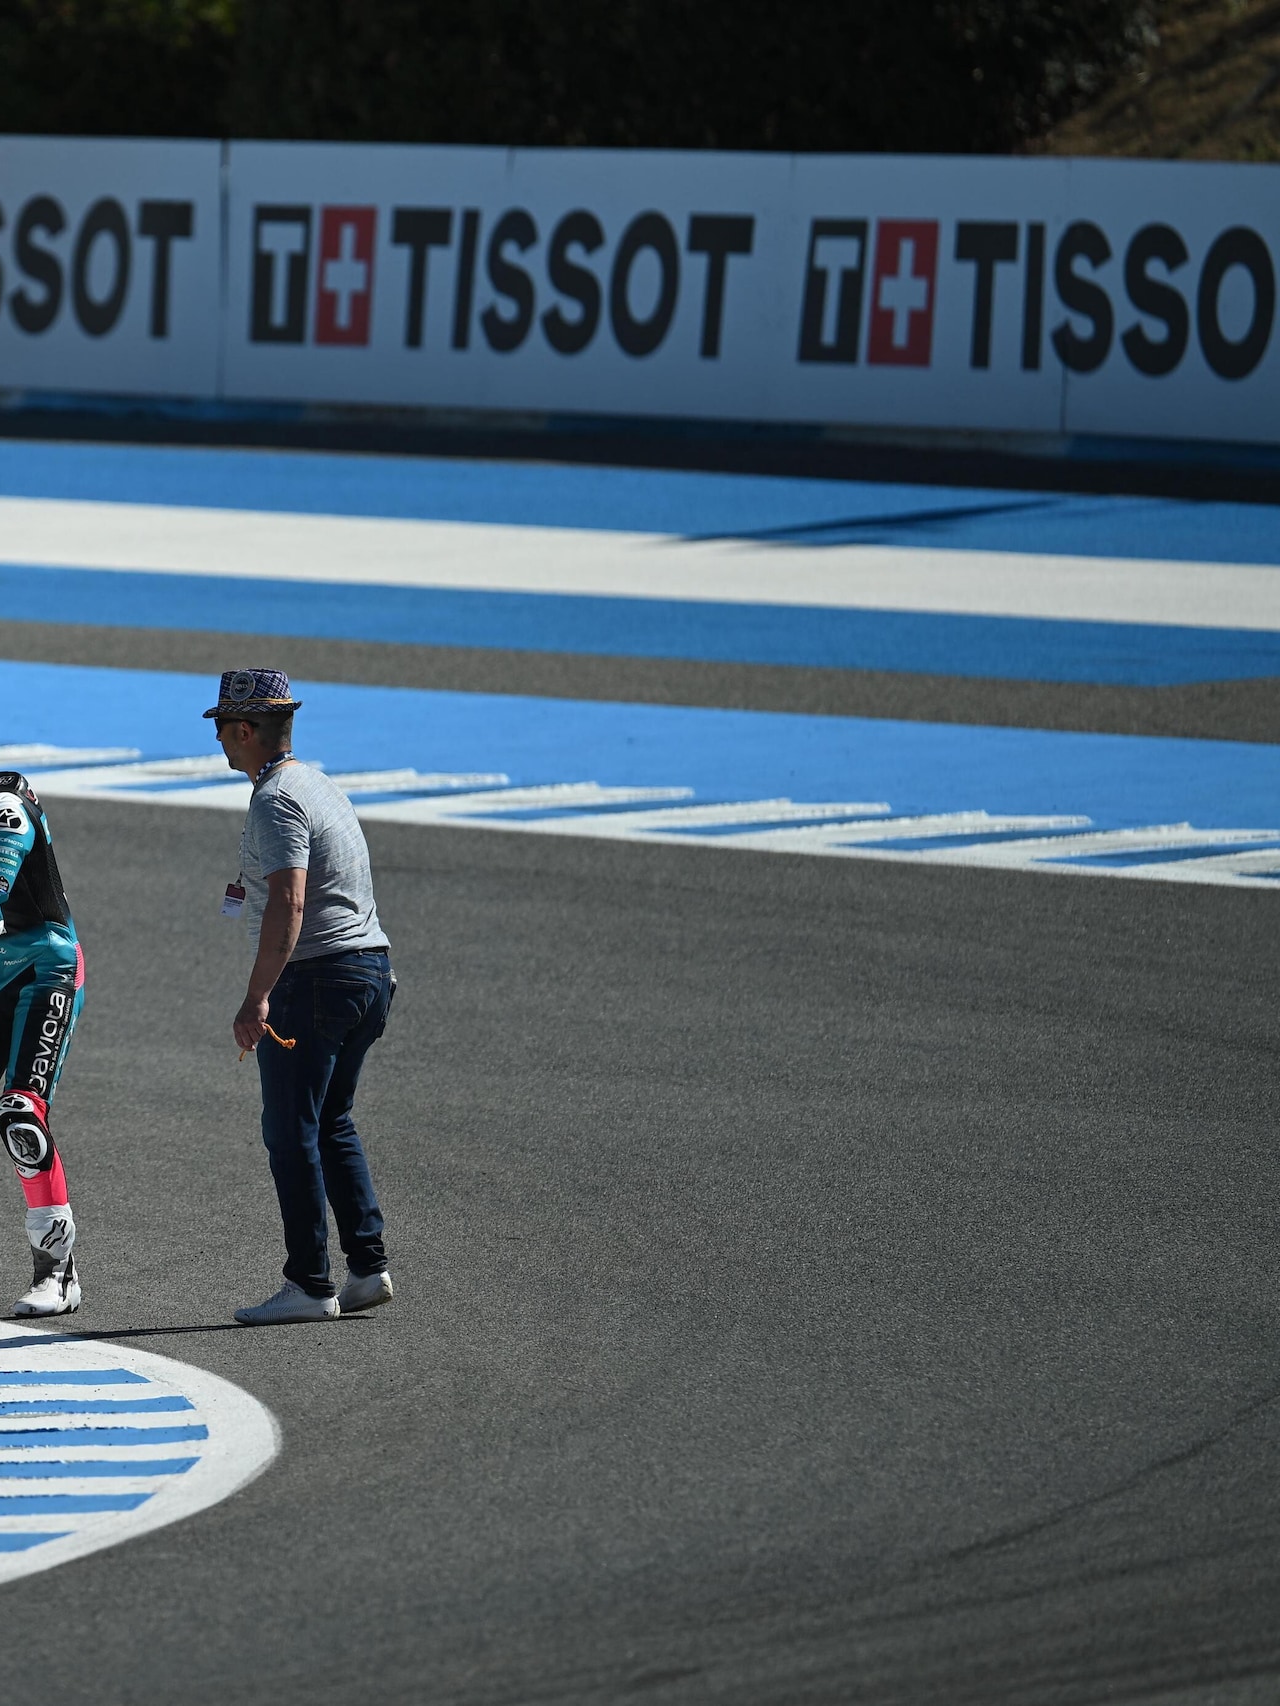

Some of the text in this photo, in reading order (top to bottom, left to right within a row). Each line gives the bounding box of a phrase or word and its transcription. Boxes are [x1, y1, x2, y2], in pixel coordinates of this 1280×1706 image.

[390, 207, 756, 361] TISSOT
[953, 219, 1277, 382] TISSO
[28, 991, 67, 1096] gaviota
